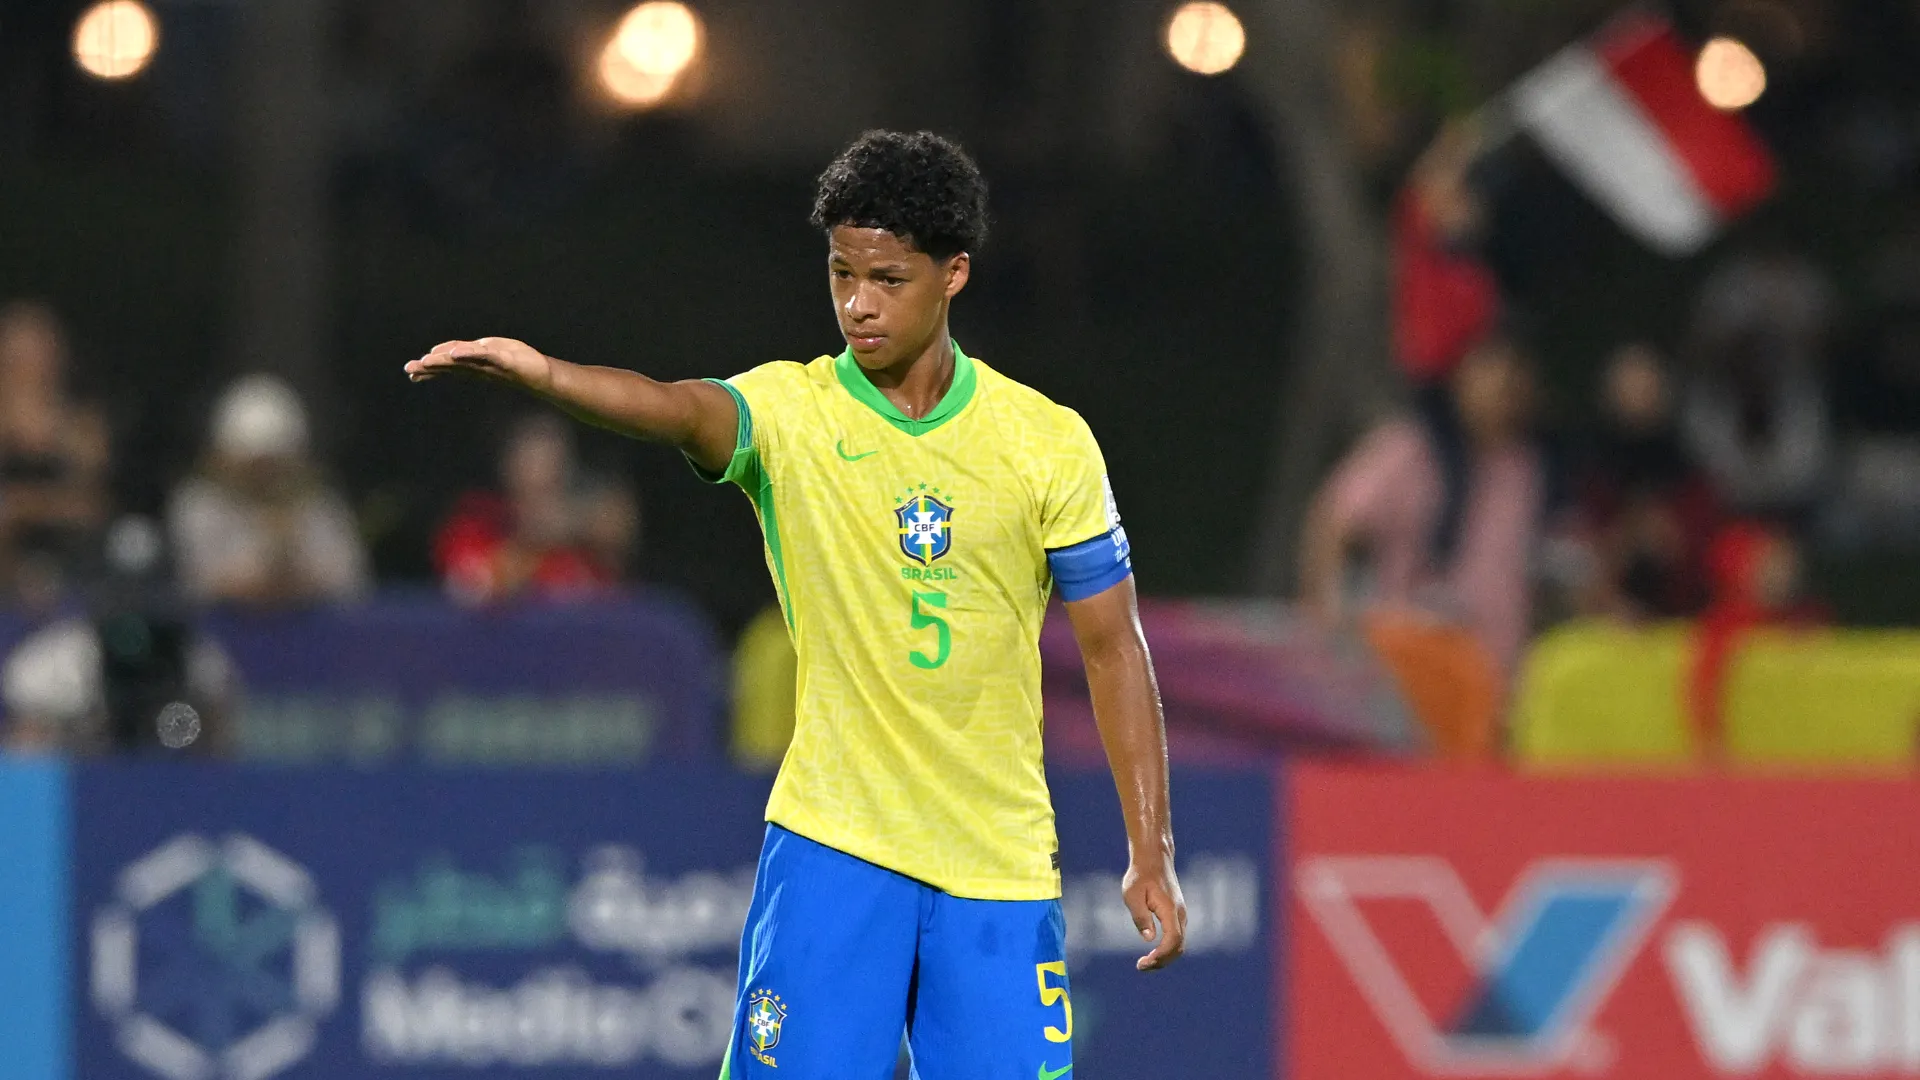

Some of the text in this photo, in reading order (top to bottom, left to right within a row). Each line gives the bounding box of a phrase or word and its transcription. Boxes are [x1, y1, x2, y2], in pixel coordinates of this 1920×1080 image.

[914, 523, 935, 532] CBF
[901, 567, 957, 581] BRASIL
[909, 588, 952, 669] 5
[1036, 960, 1073, 1043] 5
[757, 1019, 770, 1027] CBF
